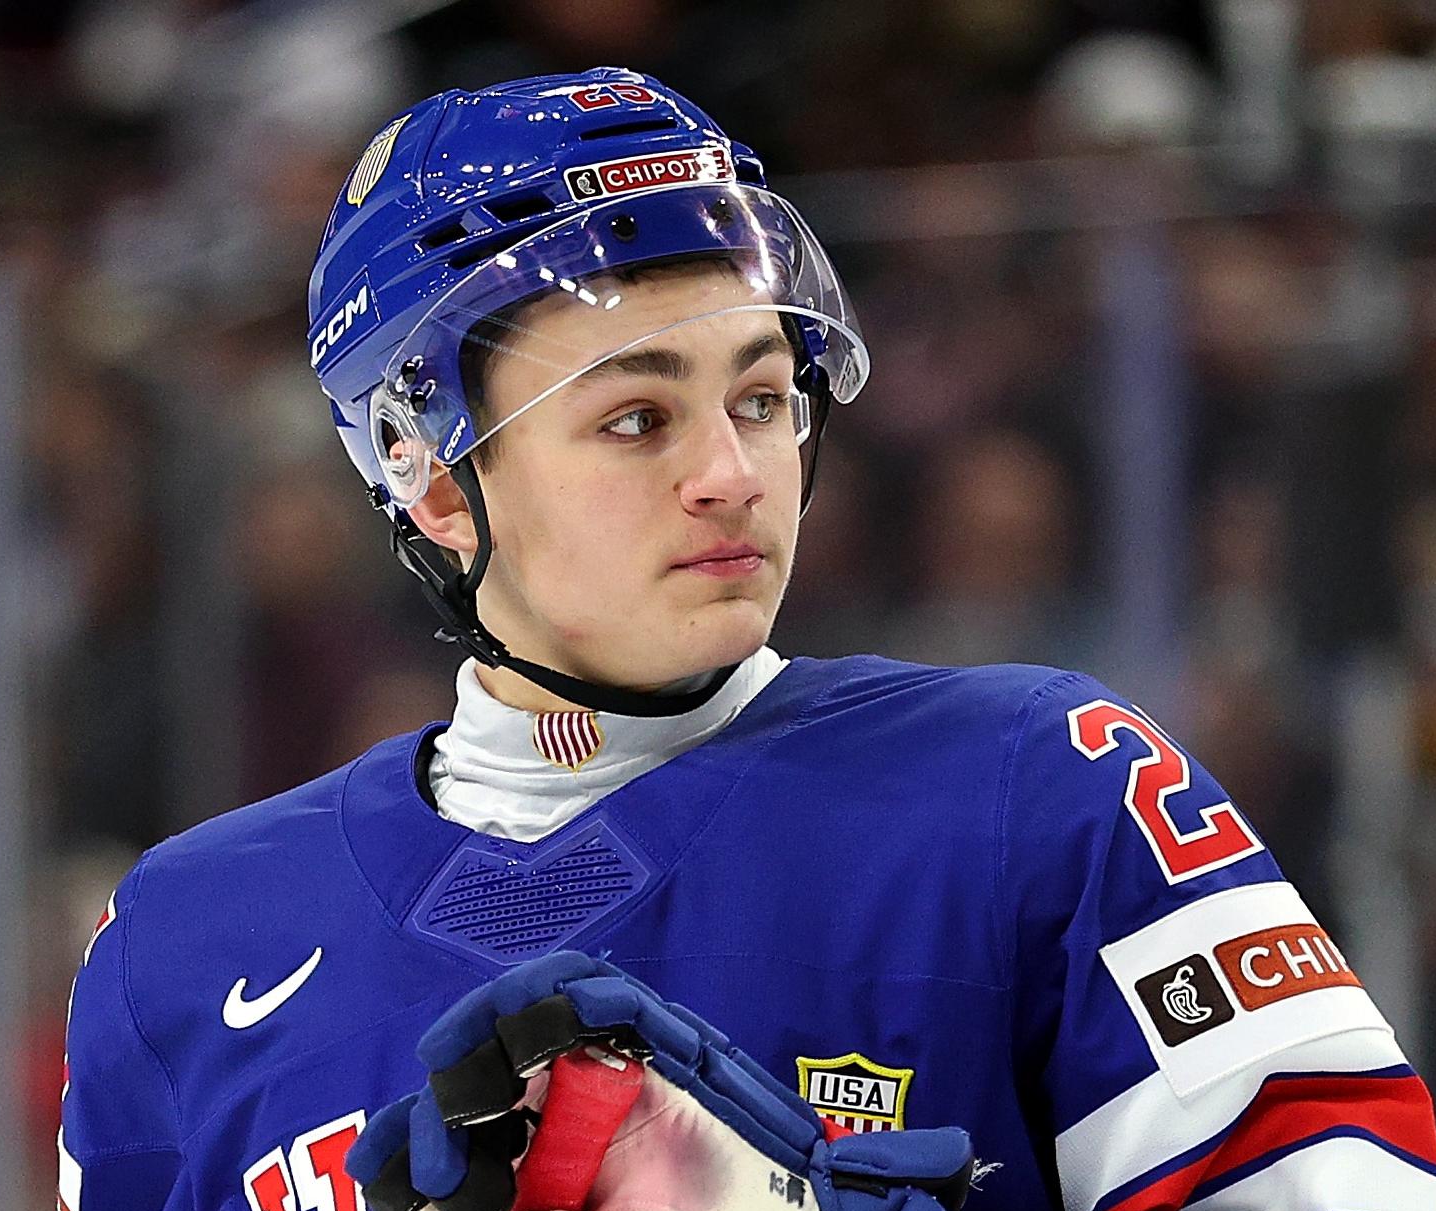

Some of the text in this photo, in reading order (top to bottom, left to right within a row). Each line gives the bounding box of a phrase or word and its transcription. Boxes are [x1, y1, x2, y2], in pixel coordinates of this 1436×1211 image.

[606, 154, 729, 188] CHIPOTE
[311, 285, 367, 369] CCM
[443, 416, 467, 460] CCM
[1067, 699, 1265, 886] 2
[819, 1075, 884, 1111] USA
